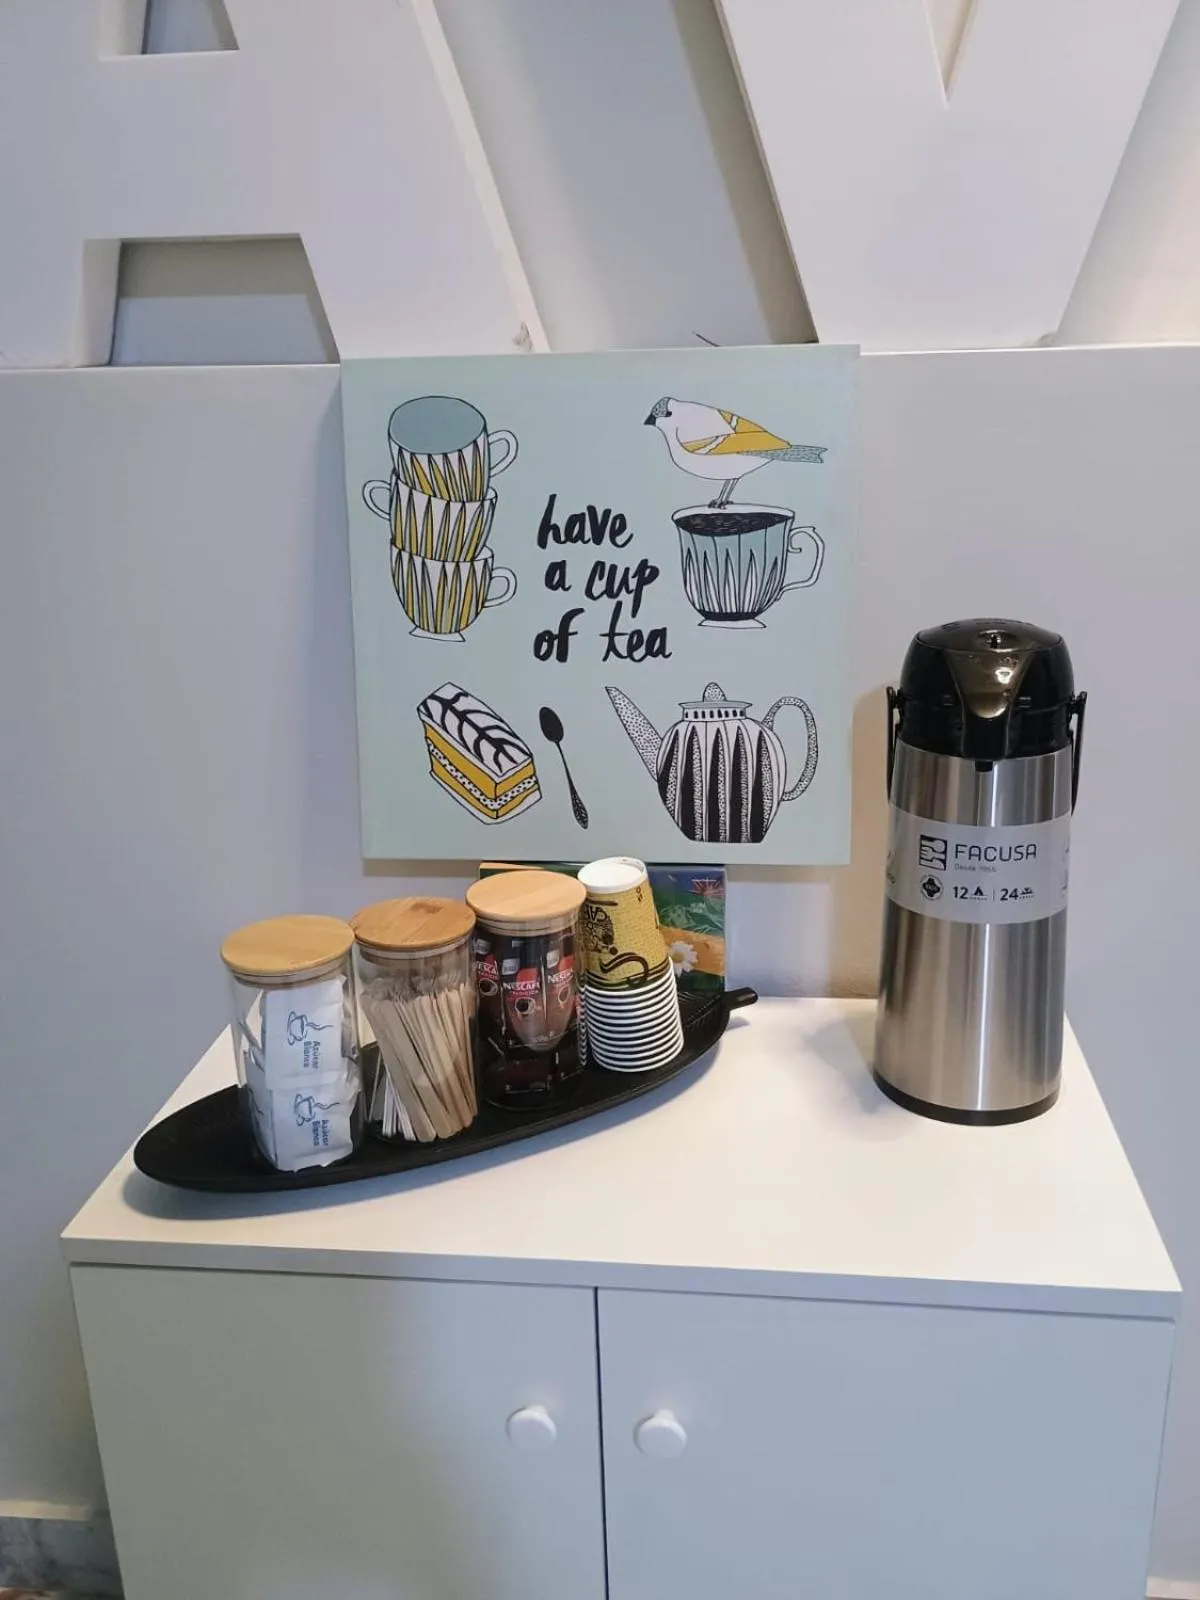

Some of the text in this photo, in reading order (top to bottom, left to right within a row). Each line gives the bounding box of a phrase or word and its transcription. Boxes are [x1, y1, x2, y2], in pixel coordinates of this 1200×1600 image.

[537, 493, 634, 550] have
[544, 558, 660, 619] a cup
[533, 600, 673, 663] of tea
[954, 843, 1038, 863] FACUSA
[953, 886, 969, 900] 12
[1000, 888, 1019, 901] 24
